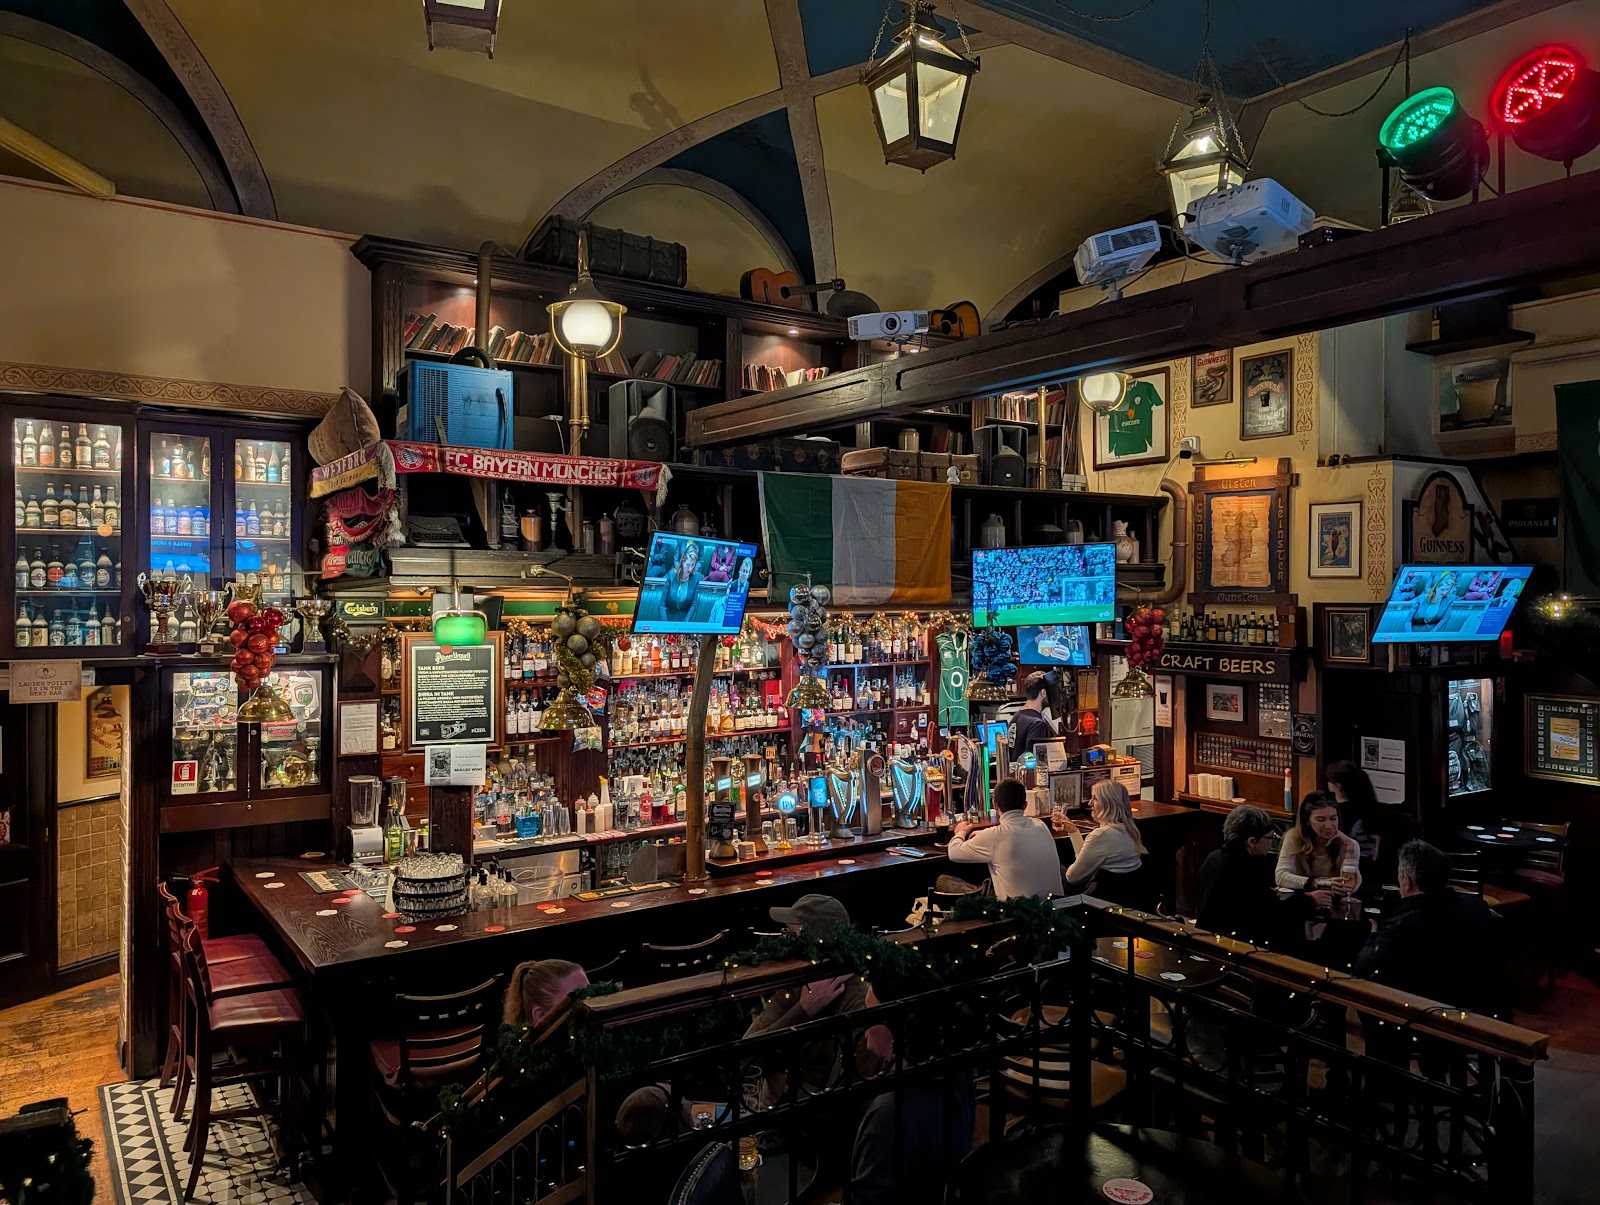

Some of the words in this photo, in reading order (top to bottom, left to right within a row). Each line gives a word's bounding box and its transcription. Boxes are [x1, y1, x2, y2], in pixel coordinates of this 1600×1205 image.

[1197, 355, 1228, 367] GUINNESS
[1248, 381, 1281, 396] GUINNESS
[322, 450, 367, 480] WEXFORD
[446, 451, 468, 468] FC
[472, 454, 539, 477] BAYERN
[542, 461, 618, 480] MÜNCHEN
[1508, 519, 1551, 528] PAULANER
[1419, 536, 1465, 553] GUINNESS
[344, 602, 379, 616] Carlsberg
[1160, 653, 1214, 670] CRAFT
[1219, 657, 1276, 675] BEERS
[782, 800, 795, 810] IPA
